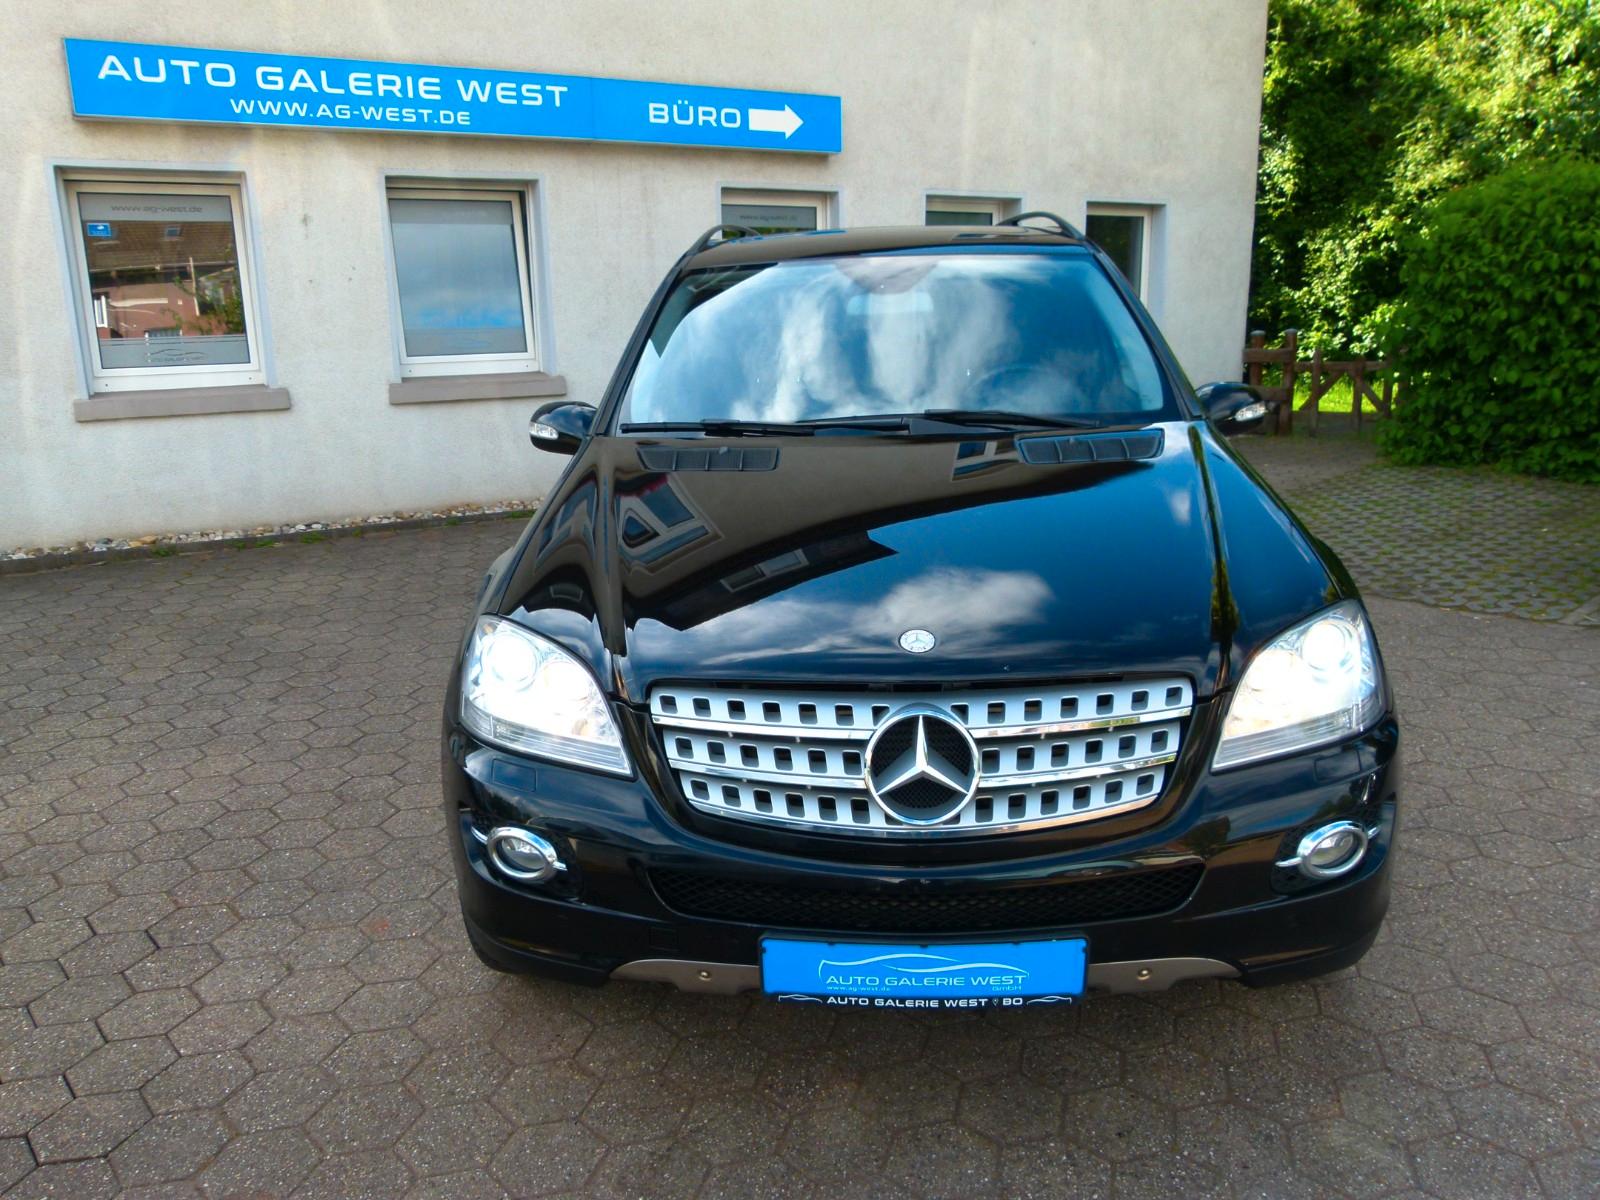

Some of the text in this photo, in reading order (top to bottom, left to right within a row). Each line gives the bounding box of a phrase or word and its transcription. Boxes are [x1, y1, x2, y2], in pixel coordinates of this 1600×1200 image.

[97, 55, 568, 107] AUTO GALERIE WEST
[230, 98, 471, 125] WWW.AG-WEST.DE
[648, 99, 742, 129] BÜRO
[826, 975, 1027, 987] AUTO GALERIE WEST
[826, 996, 1024, 1007] AUTO GALERIE WEST BO
